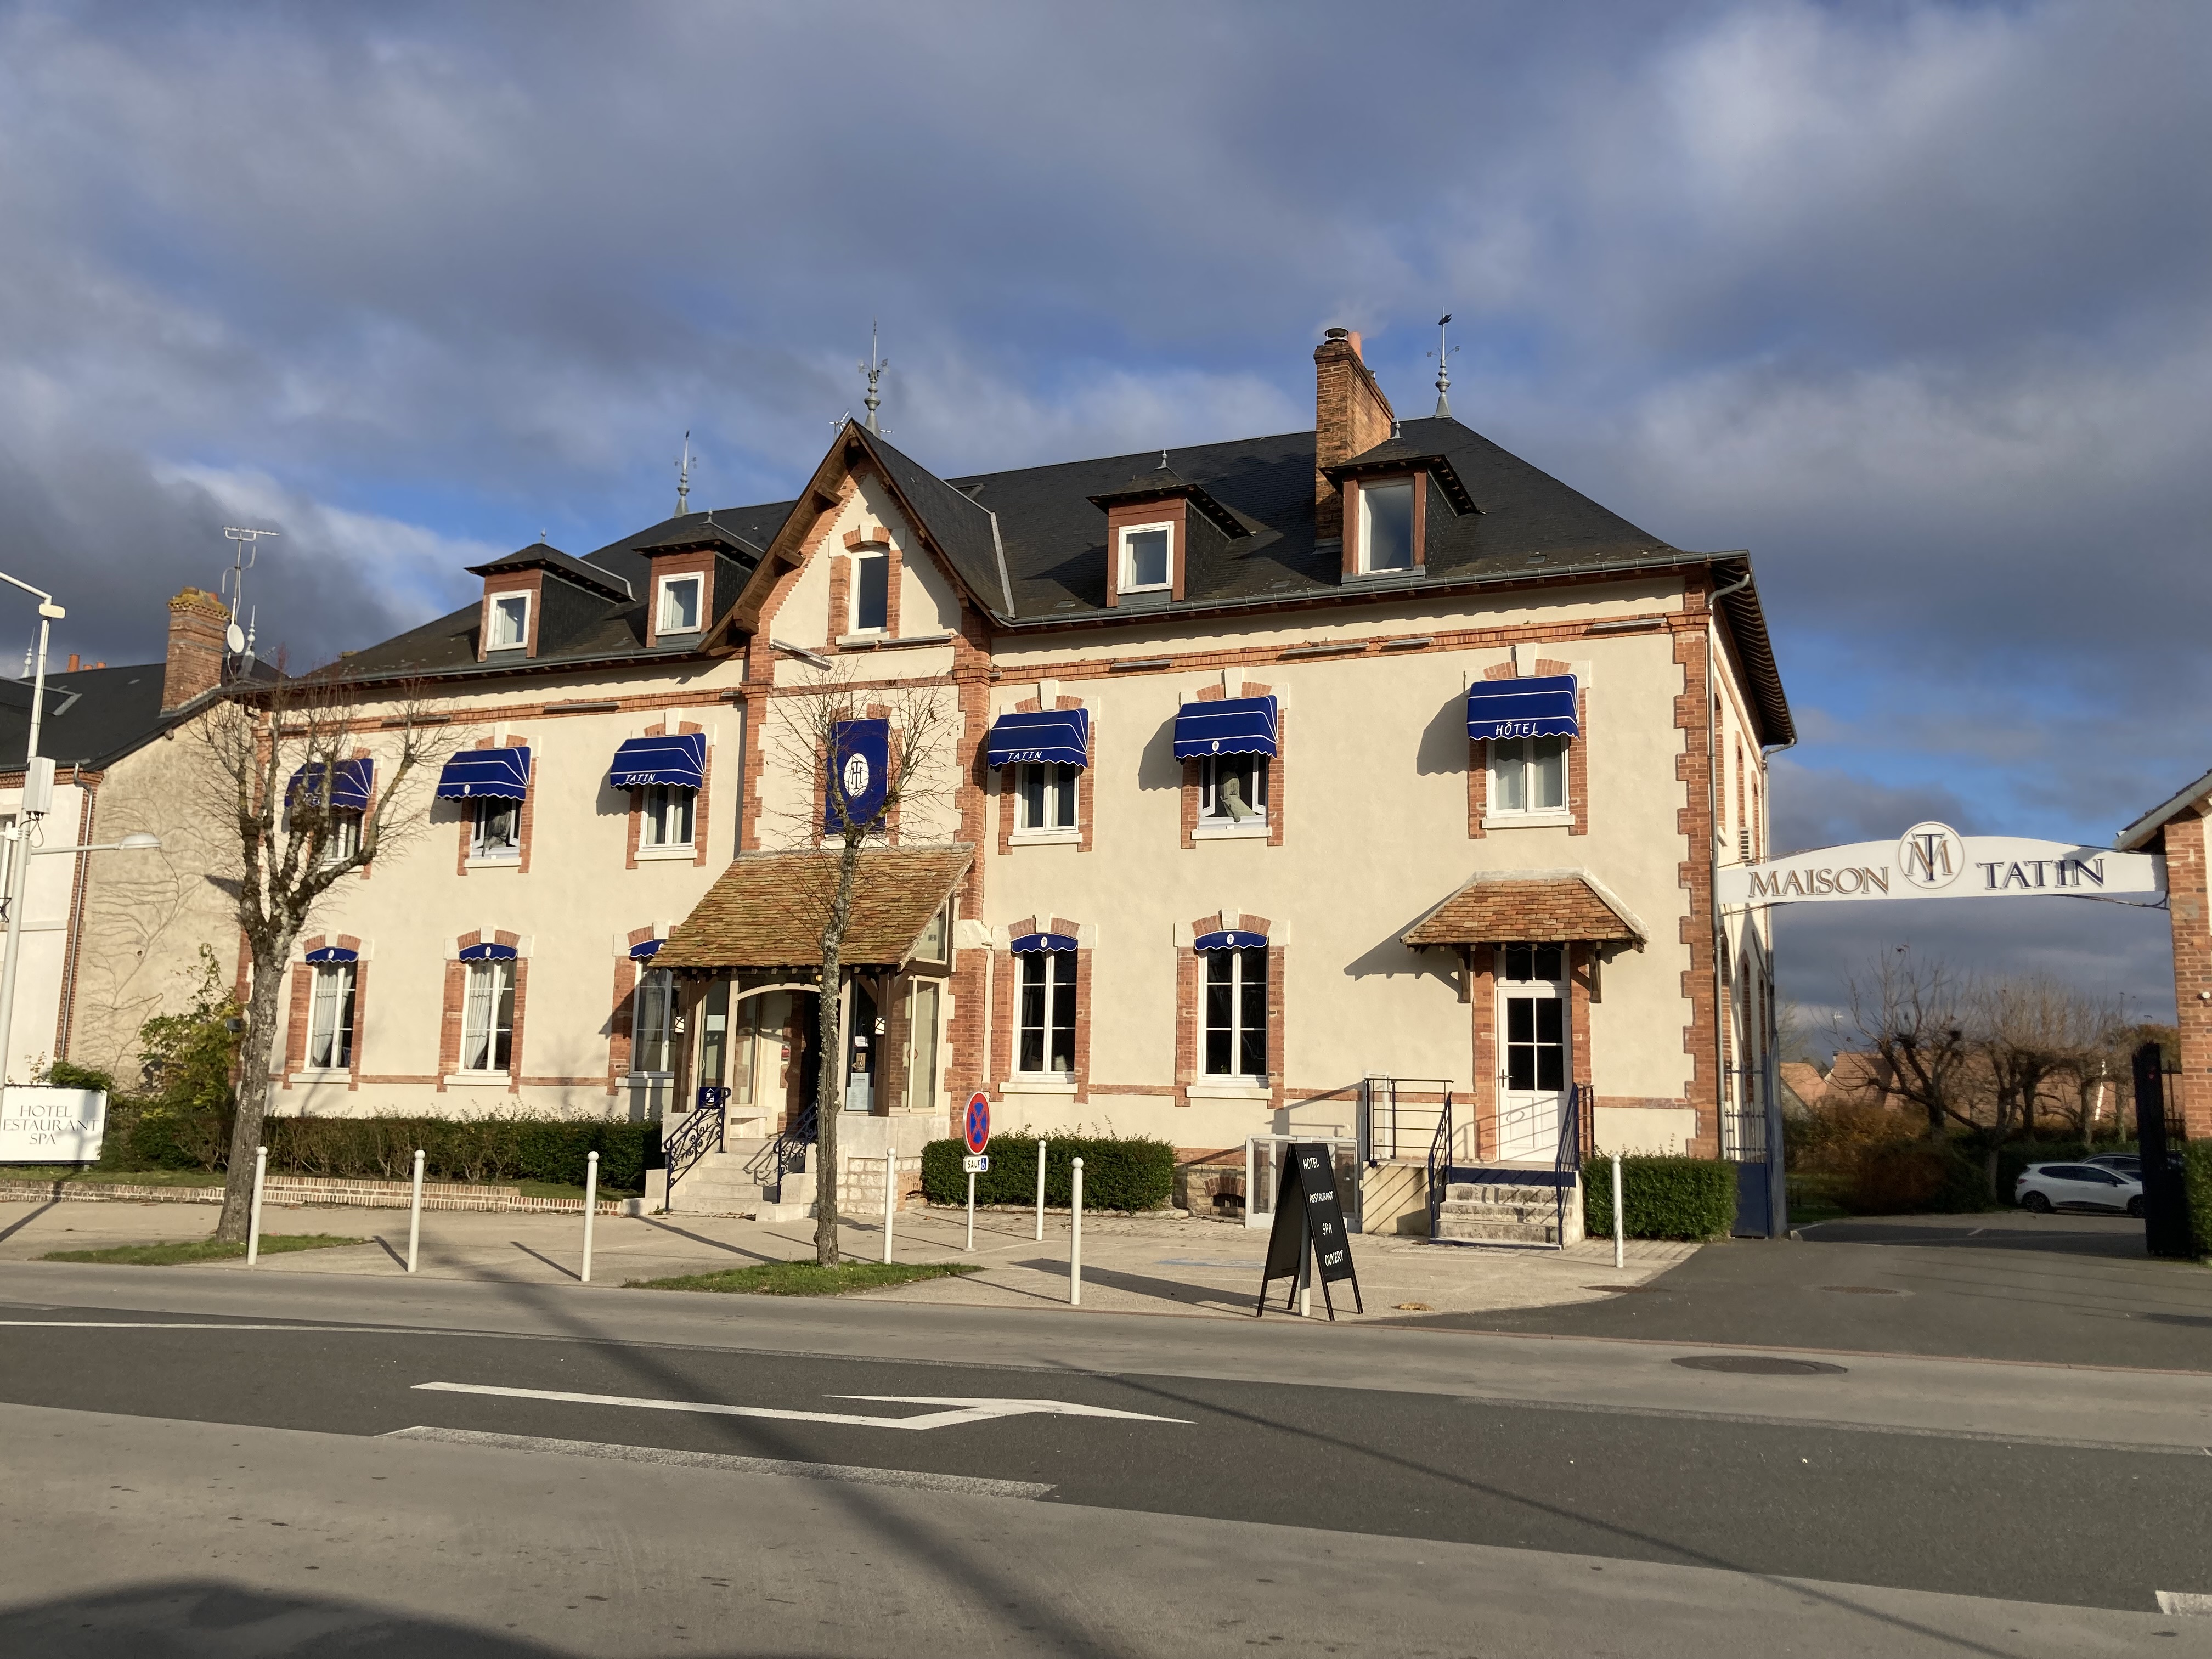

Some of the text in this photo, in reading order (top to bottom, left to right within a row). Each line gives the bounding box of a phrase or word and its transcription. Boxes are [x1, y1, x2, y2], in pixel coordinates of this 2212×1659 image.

[1496, 721, 1539, 736] HÔTEL
[1008, 751, 1043, 760] TATIN
[625, 774, 656, 782] TATIN
[1748, 866, 1889, 898] MAISON
[1975, 854, 2105, 890] TATIN
[20, 1105, 72, 1117] HOTEL
[3, 1119, 99, 1131] ESTAURANT
[29, 1133, 56, 1145] SPA
[967, 1160, 980, 1169] SAUF
[1303, 1157, 1319, 1170] HOTEL
[1309, 1191, 1333, 1203] RESTAURANT
[1322, 1222, 1333, 1235] SPA
[1325, 1249, 1343, 1267] OUVERT
